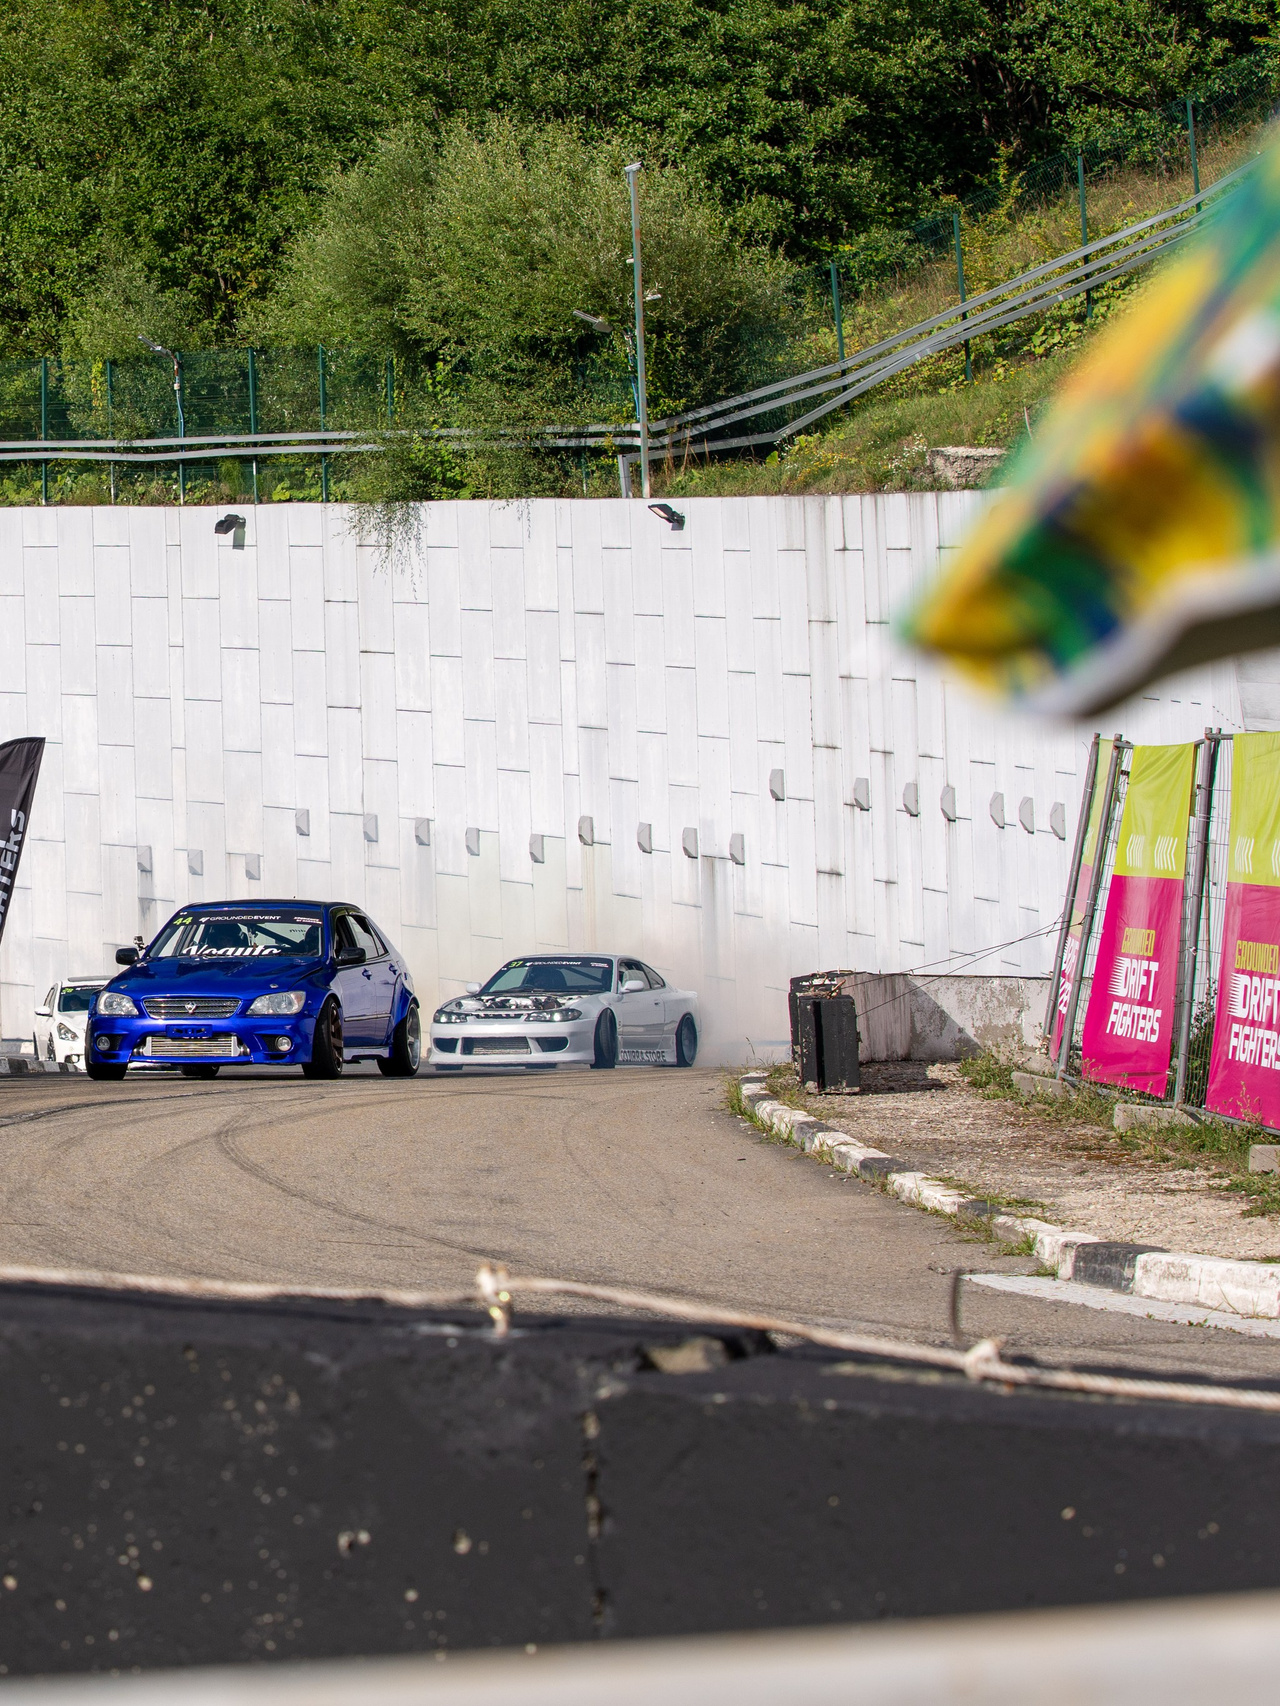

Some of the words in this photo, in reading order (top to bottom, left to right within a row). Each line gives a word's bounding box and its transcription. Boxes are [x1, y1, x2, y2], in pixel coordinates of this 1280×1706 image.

[173, 916, 193, 925] 44
[1235, 940, 1279, 974] GROUNDED
[1111, 957, 1159, 1001] DRIFT
[1230, 973, 1280, 1024] DRIFT
[1106, 1001, 1162, 1043] FIGHTERS
